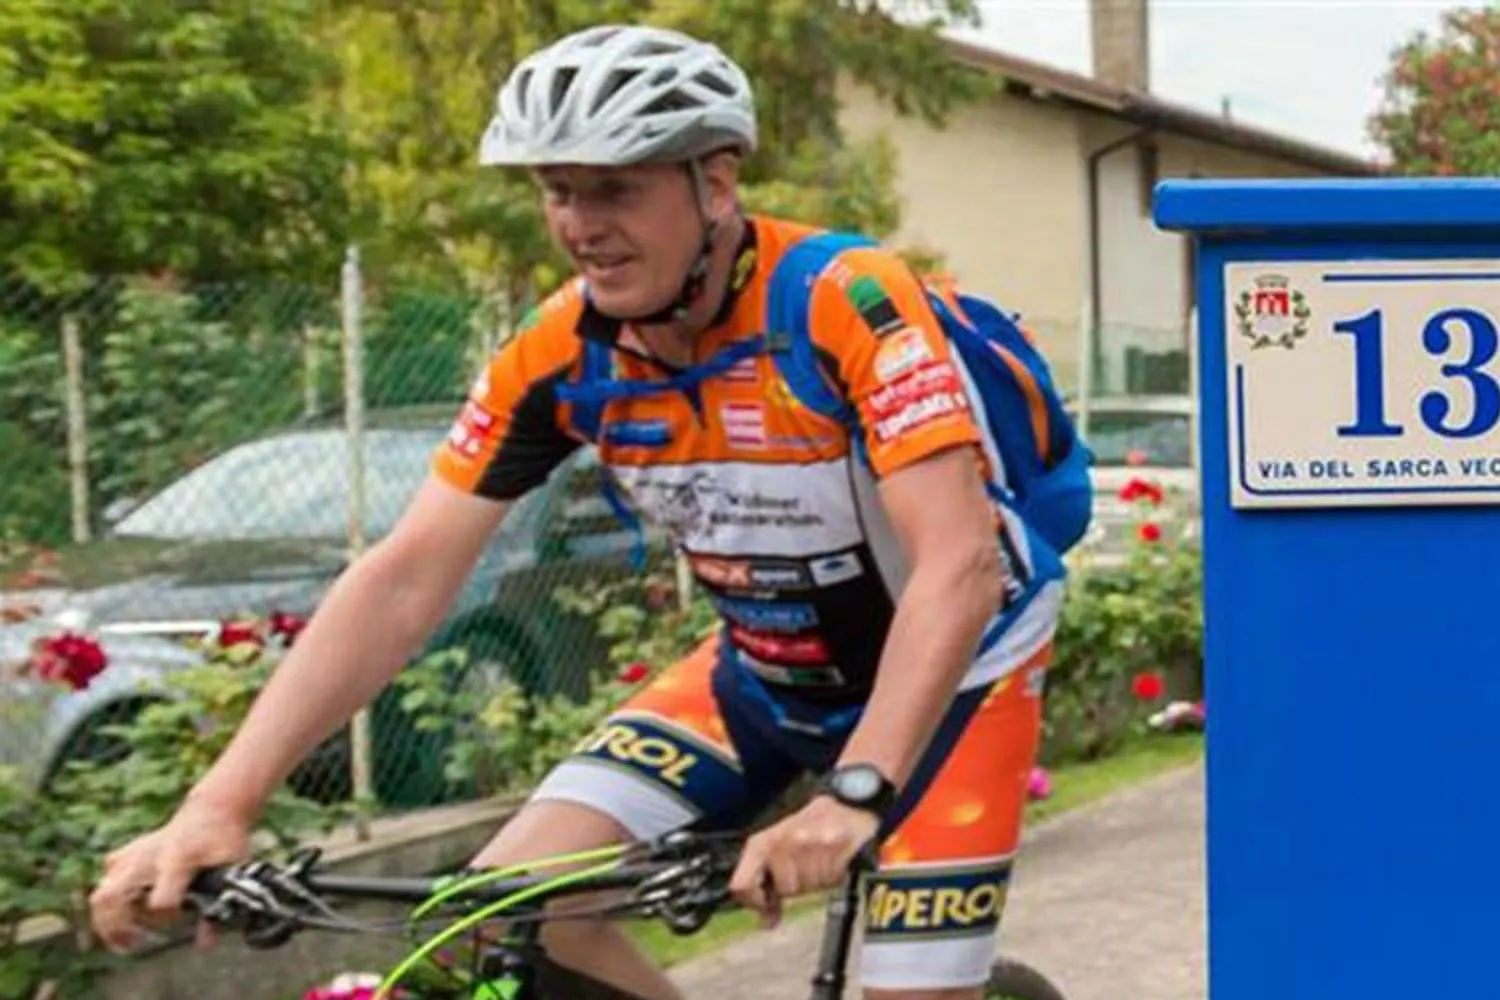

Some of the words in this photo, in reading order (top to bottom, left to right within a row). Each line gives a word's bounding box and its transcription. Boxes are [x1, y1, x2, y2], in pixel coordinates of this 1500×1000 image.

[1259, 461, 1297, 479] VIA
[1309, 460, 1354, 478] DEL
[1367, 459, 1448, 478] SARCA
